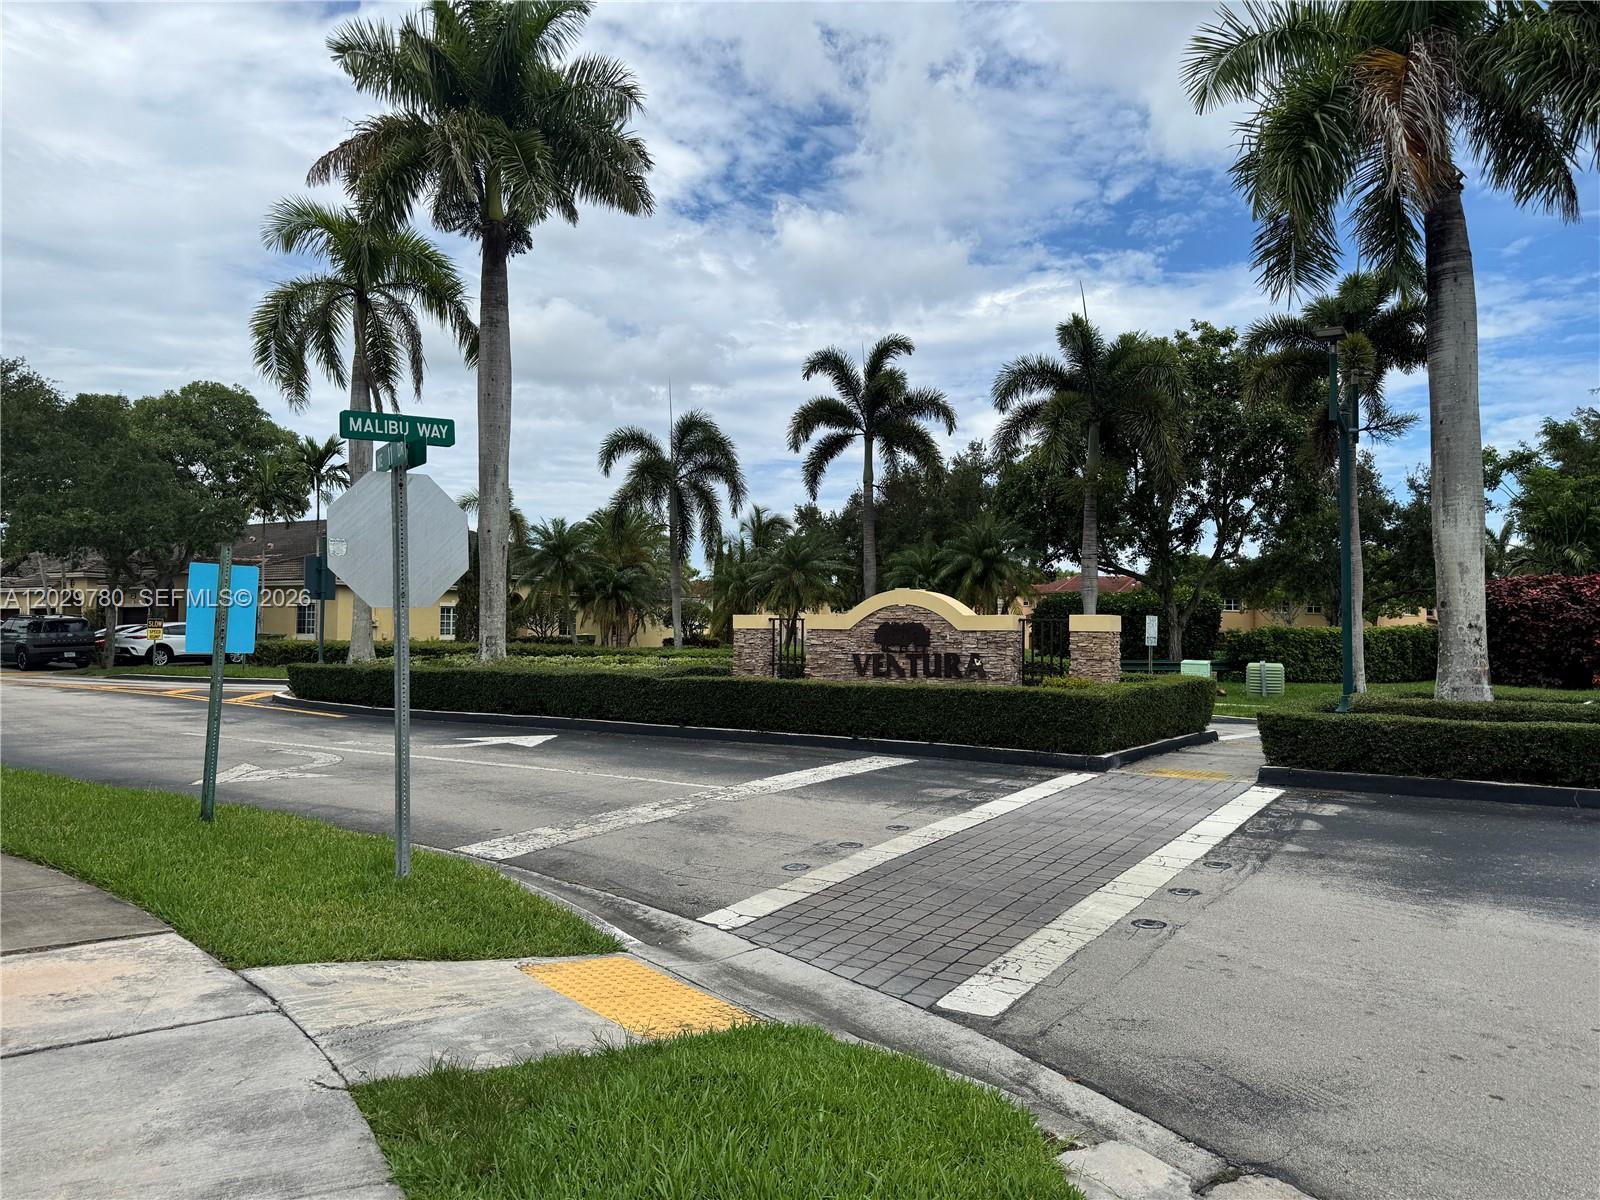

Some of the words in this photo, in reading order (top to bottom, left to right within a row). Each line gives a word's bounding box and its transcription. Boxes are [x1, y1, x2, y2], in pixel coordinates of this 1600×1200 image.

[349, 417, 409, 436] MALIBU
[417, 422, 448, 439] WAY
[852, 653, 987, 678] VENTURA
